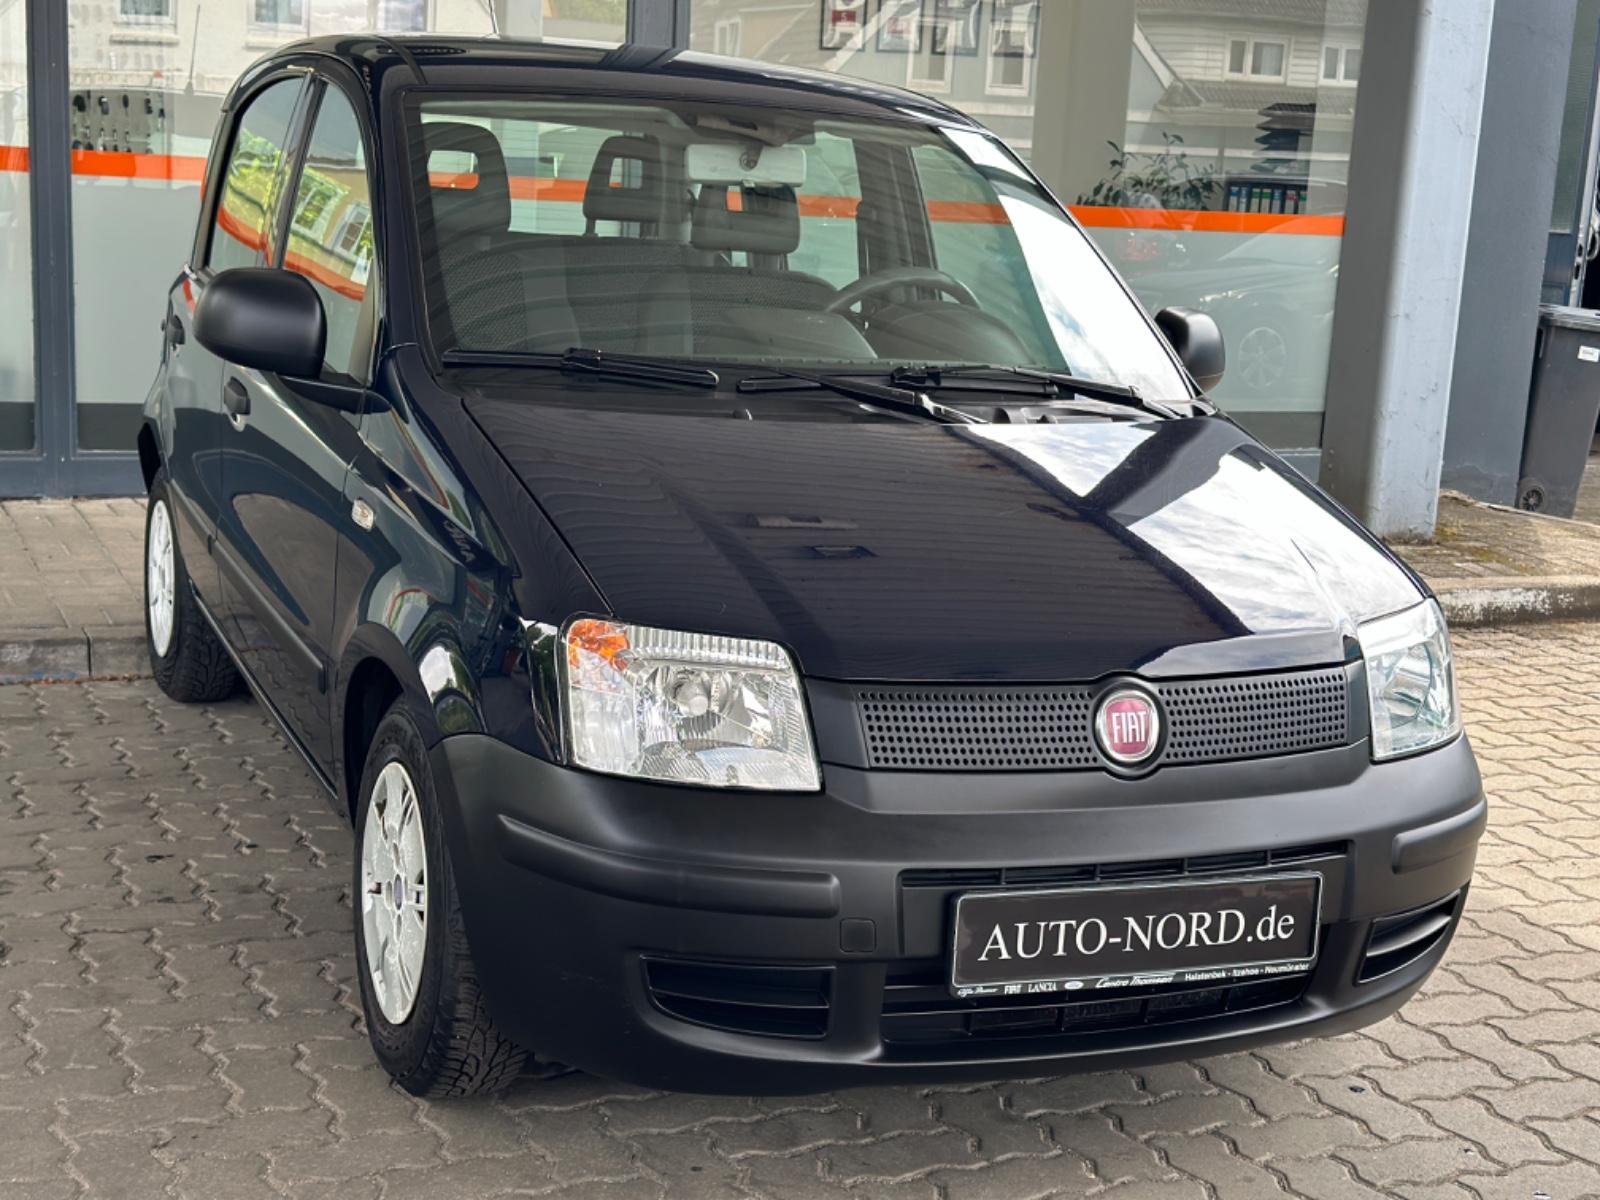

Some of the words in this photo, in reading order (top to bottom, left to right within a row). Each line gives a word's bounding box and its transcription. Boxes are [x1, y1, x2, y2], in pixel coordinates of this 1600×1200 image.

[1112, 711, 1146, 744] FIAT
[977, 904, 1295, 962] AUTO-NORD.de
[1028, 981, 1058, 993] LANCIA
